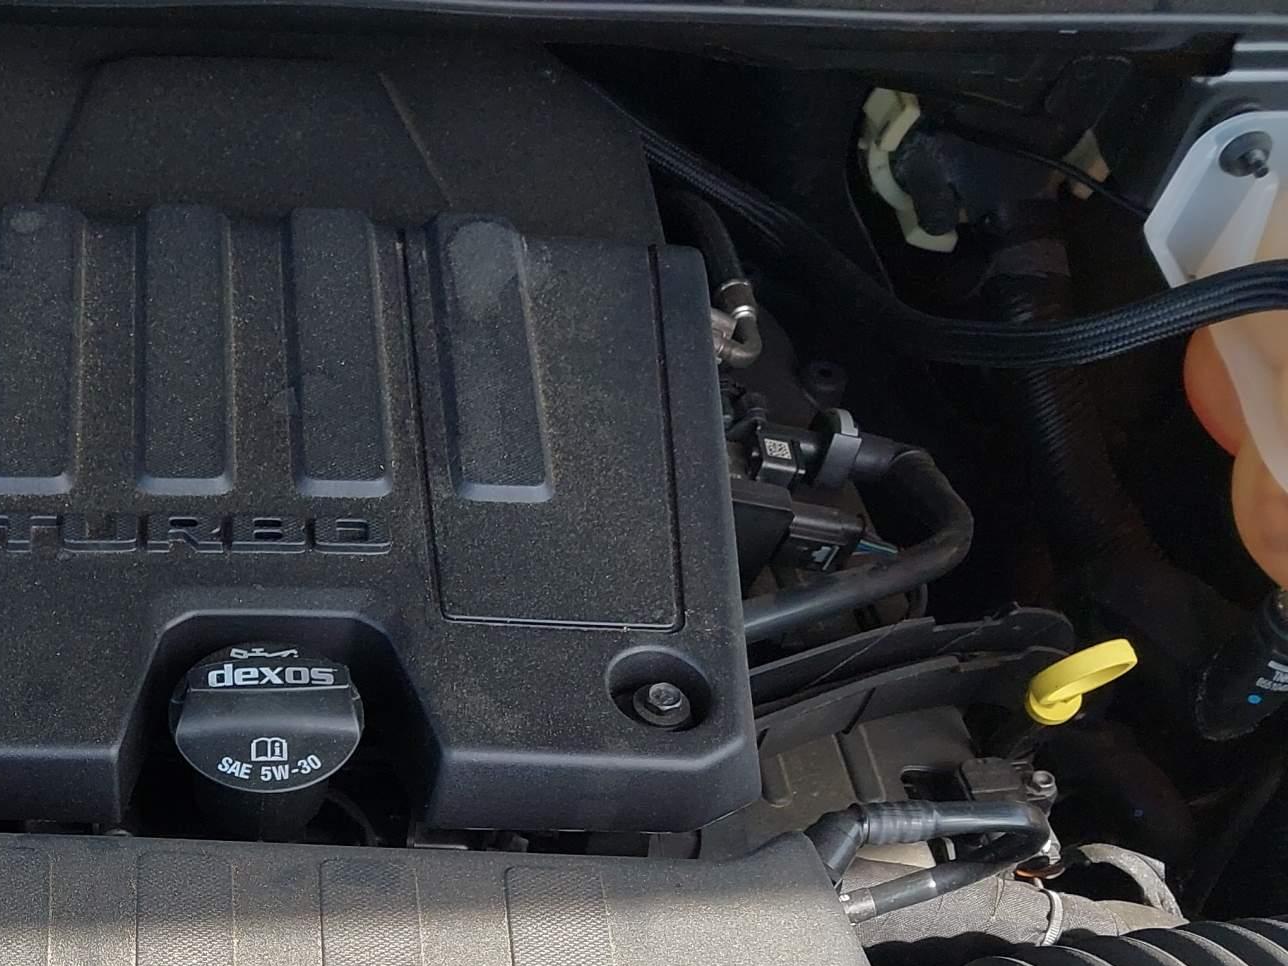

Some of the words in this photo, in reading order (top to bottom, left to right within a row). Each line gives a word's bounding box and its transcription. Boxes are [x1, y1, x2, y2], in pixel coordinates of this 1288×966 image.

[208, 663, 335, 688] dexos
[218, 754, 253, 779] SAE
[260, 754, 322, 781] 5W-30
